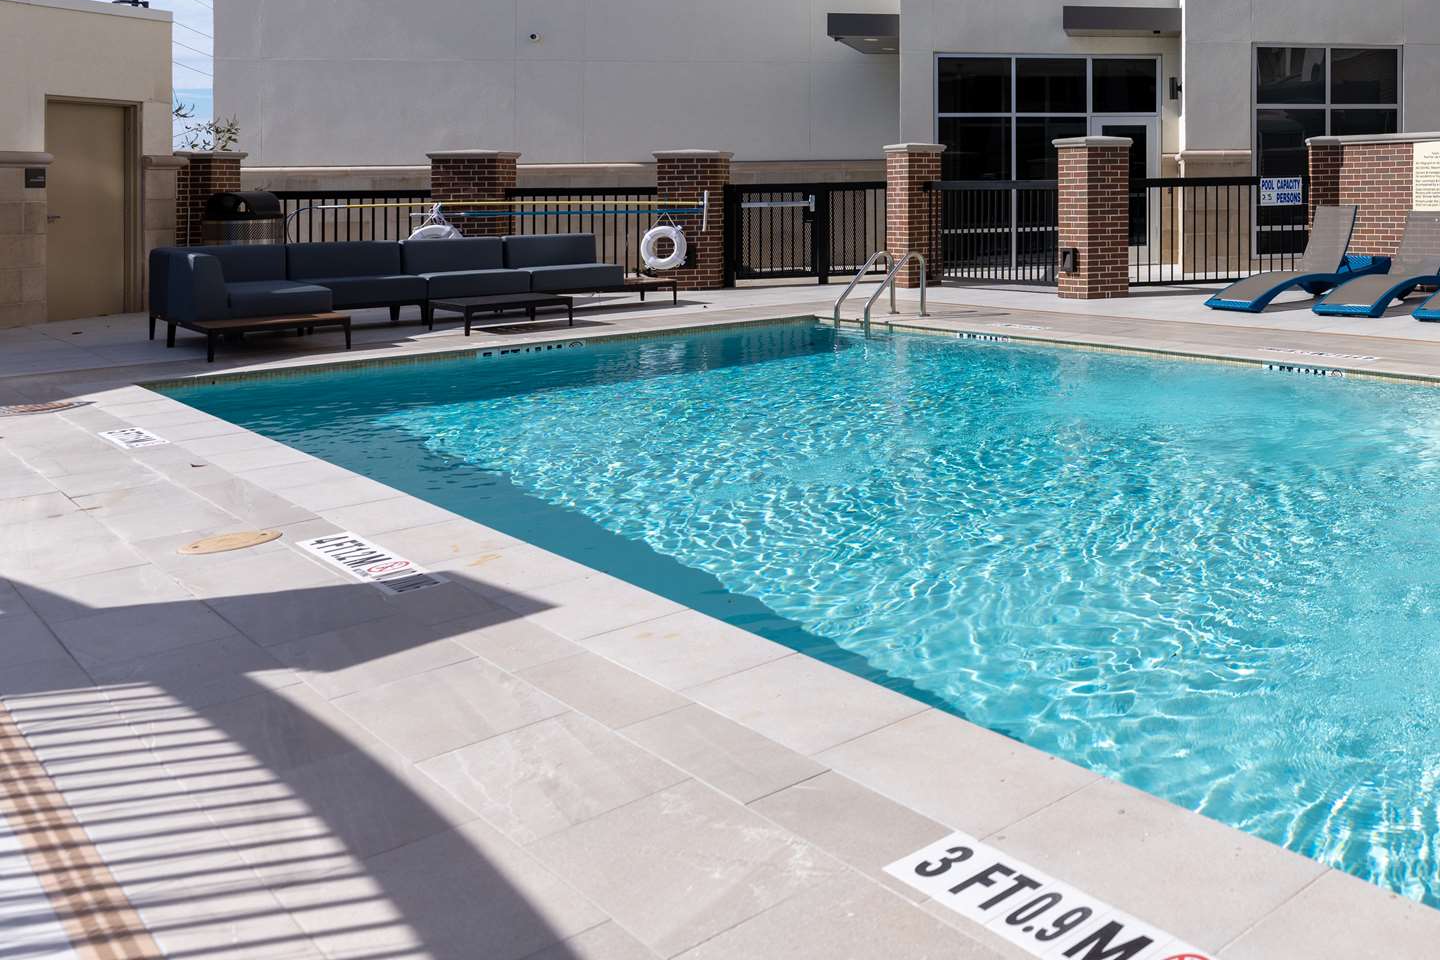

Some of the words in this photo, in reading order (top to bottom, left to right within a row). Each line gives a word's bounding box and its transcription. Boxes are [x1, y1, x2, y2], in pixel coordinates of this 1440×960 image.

[1261, 179, 1275, 190] POOL
[1276, 178, 1301, 190] CAPACITY
[1276, 192, 1301, 203] PERSONS
[914, 846, 974, 878] 3
